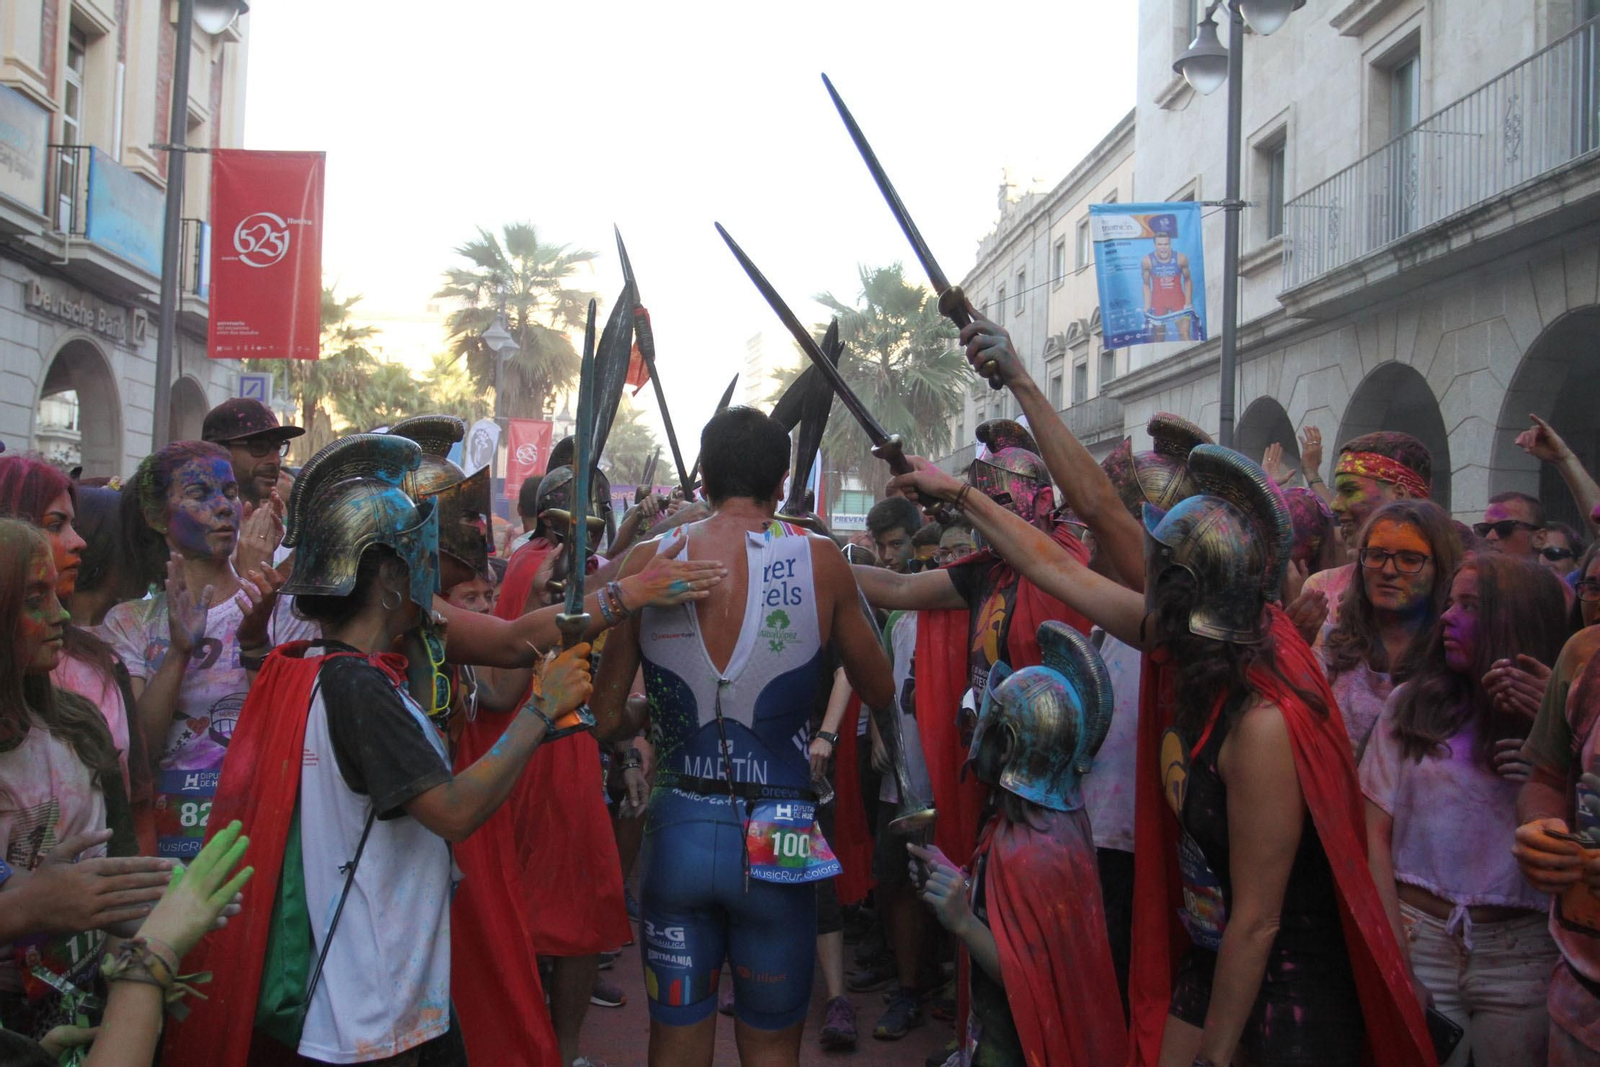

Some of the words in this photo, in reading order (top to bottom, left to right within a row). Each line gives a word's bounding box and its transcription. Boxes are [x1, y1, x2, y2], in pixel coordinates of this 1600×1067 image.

[33, 282, 95, 328] Deutsche
[98, 307, 127, 344] Bank
[685, 752, 768, 785] MARTÍN
[181, 802, 213, 827] 82
[772, 831, 811, 858] 100
